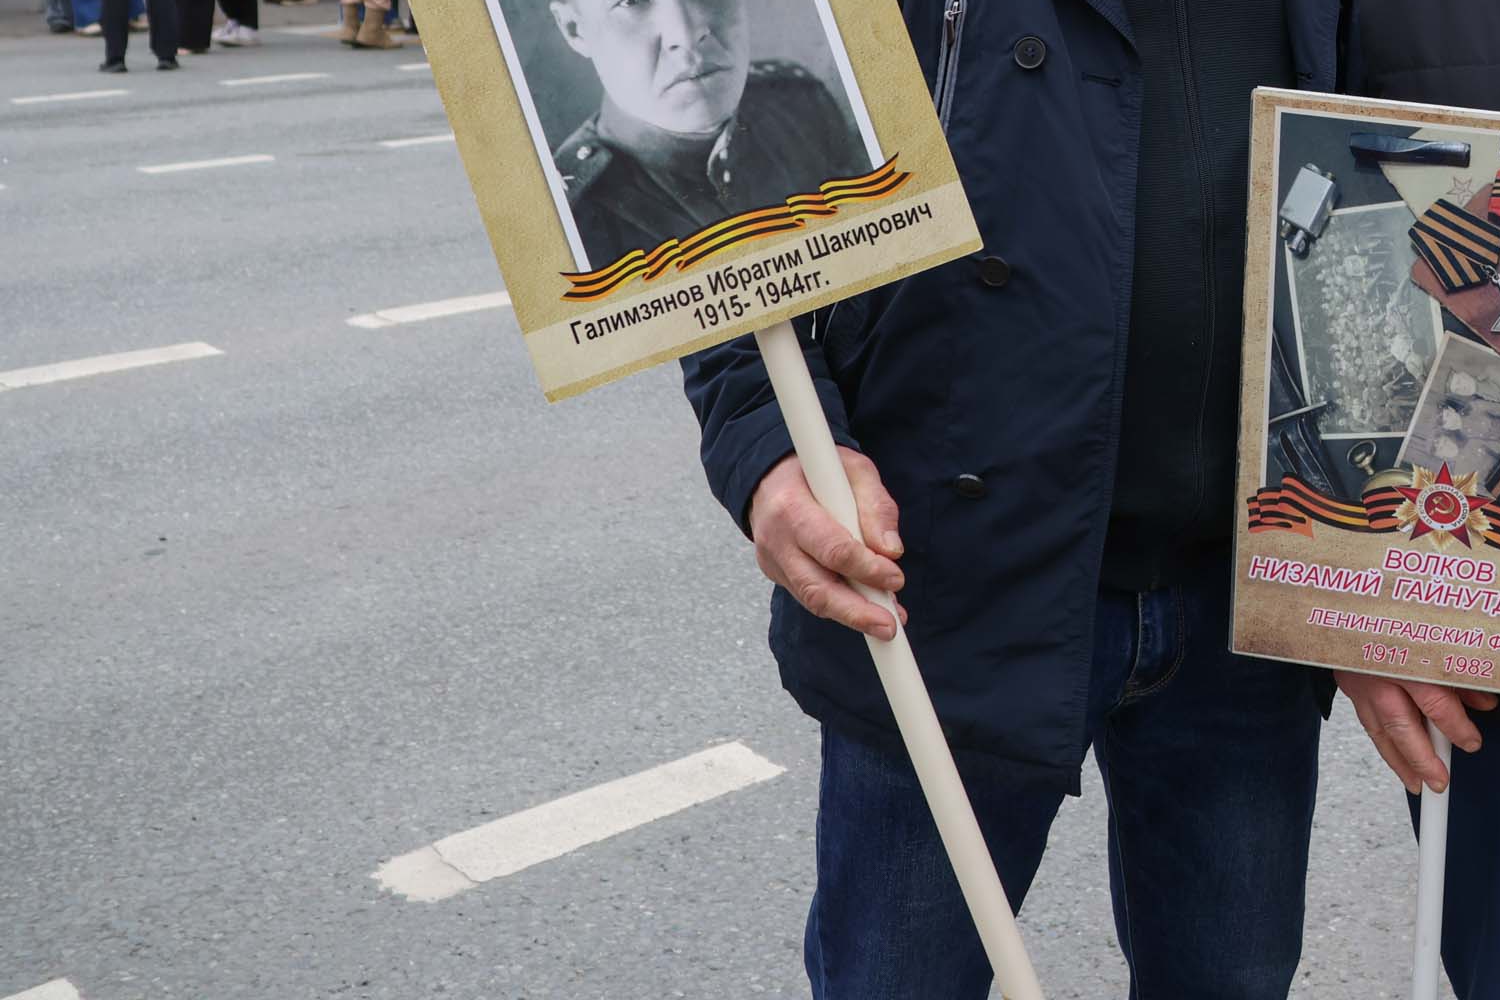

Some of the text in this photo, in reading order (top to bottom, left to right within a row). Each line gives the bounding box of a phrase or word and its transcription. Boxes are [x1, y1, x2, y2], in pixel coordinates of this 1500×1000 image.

[569, 202, 933, 345] Галимзянов Ибрагим Шакирович
[694, 271, 831, 330] 1915- 1944гг.
[1250, 557, 1382, 595] НИЗАМИЙ
[1384, 549, 1495, 582] ВОЛКОВ
[1308, 608, 1484, 648] ЛЕНИНГРАДСКИЙ
[1362, 643, 1409, 665] 1911
[1444, 655, 1494, 677] 1982
